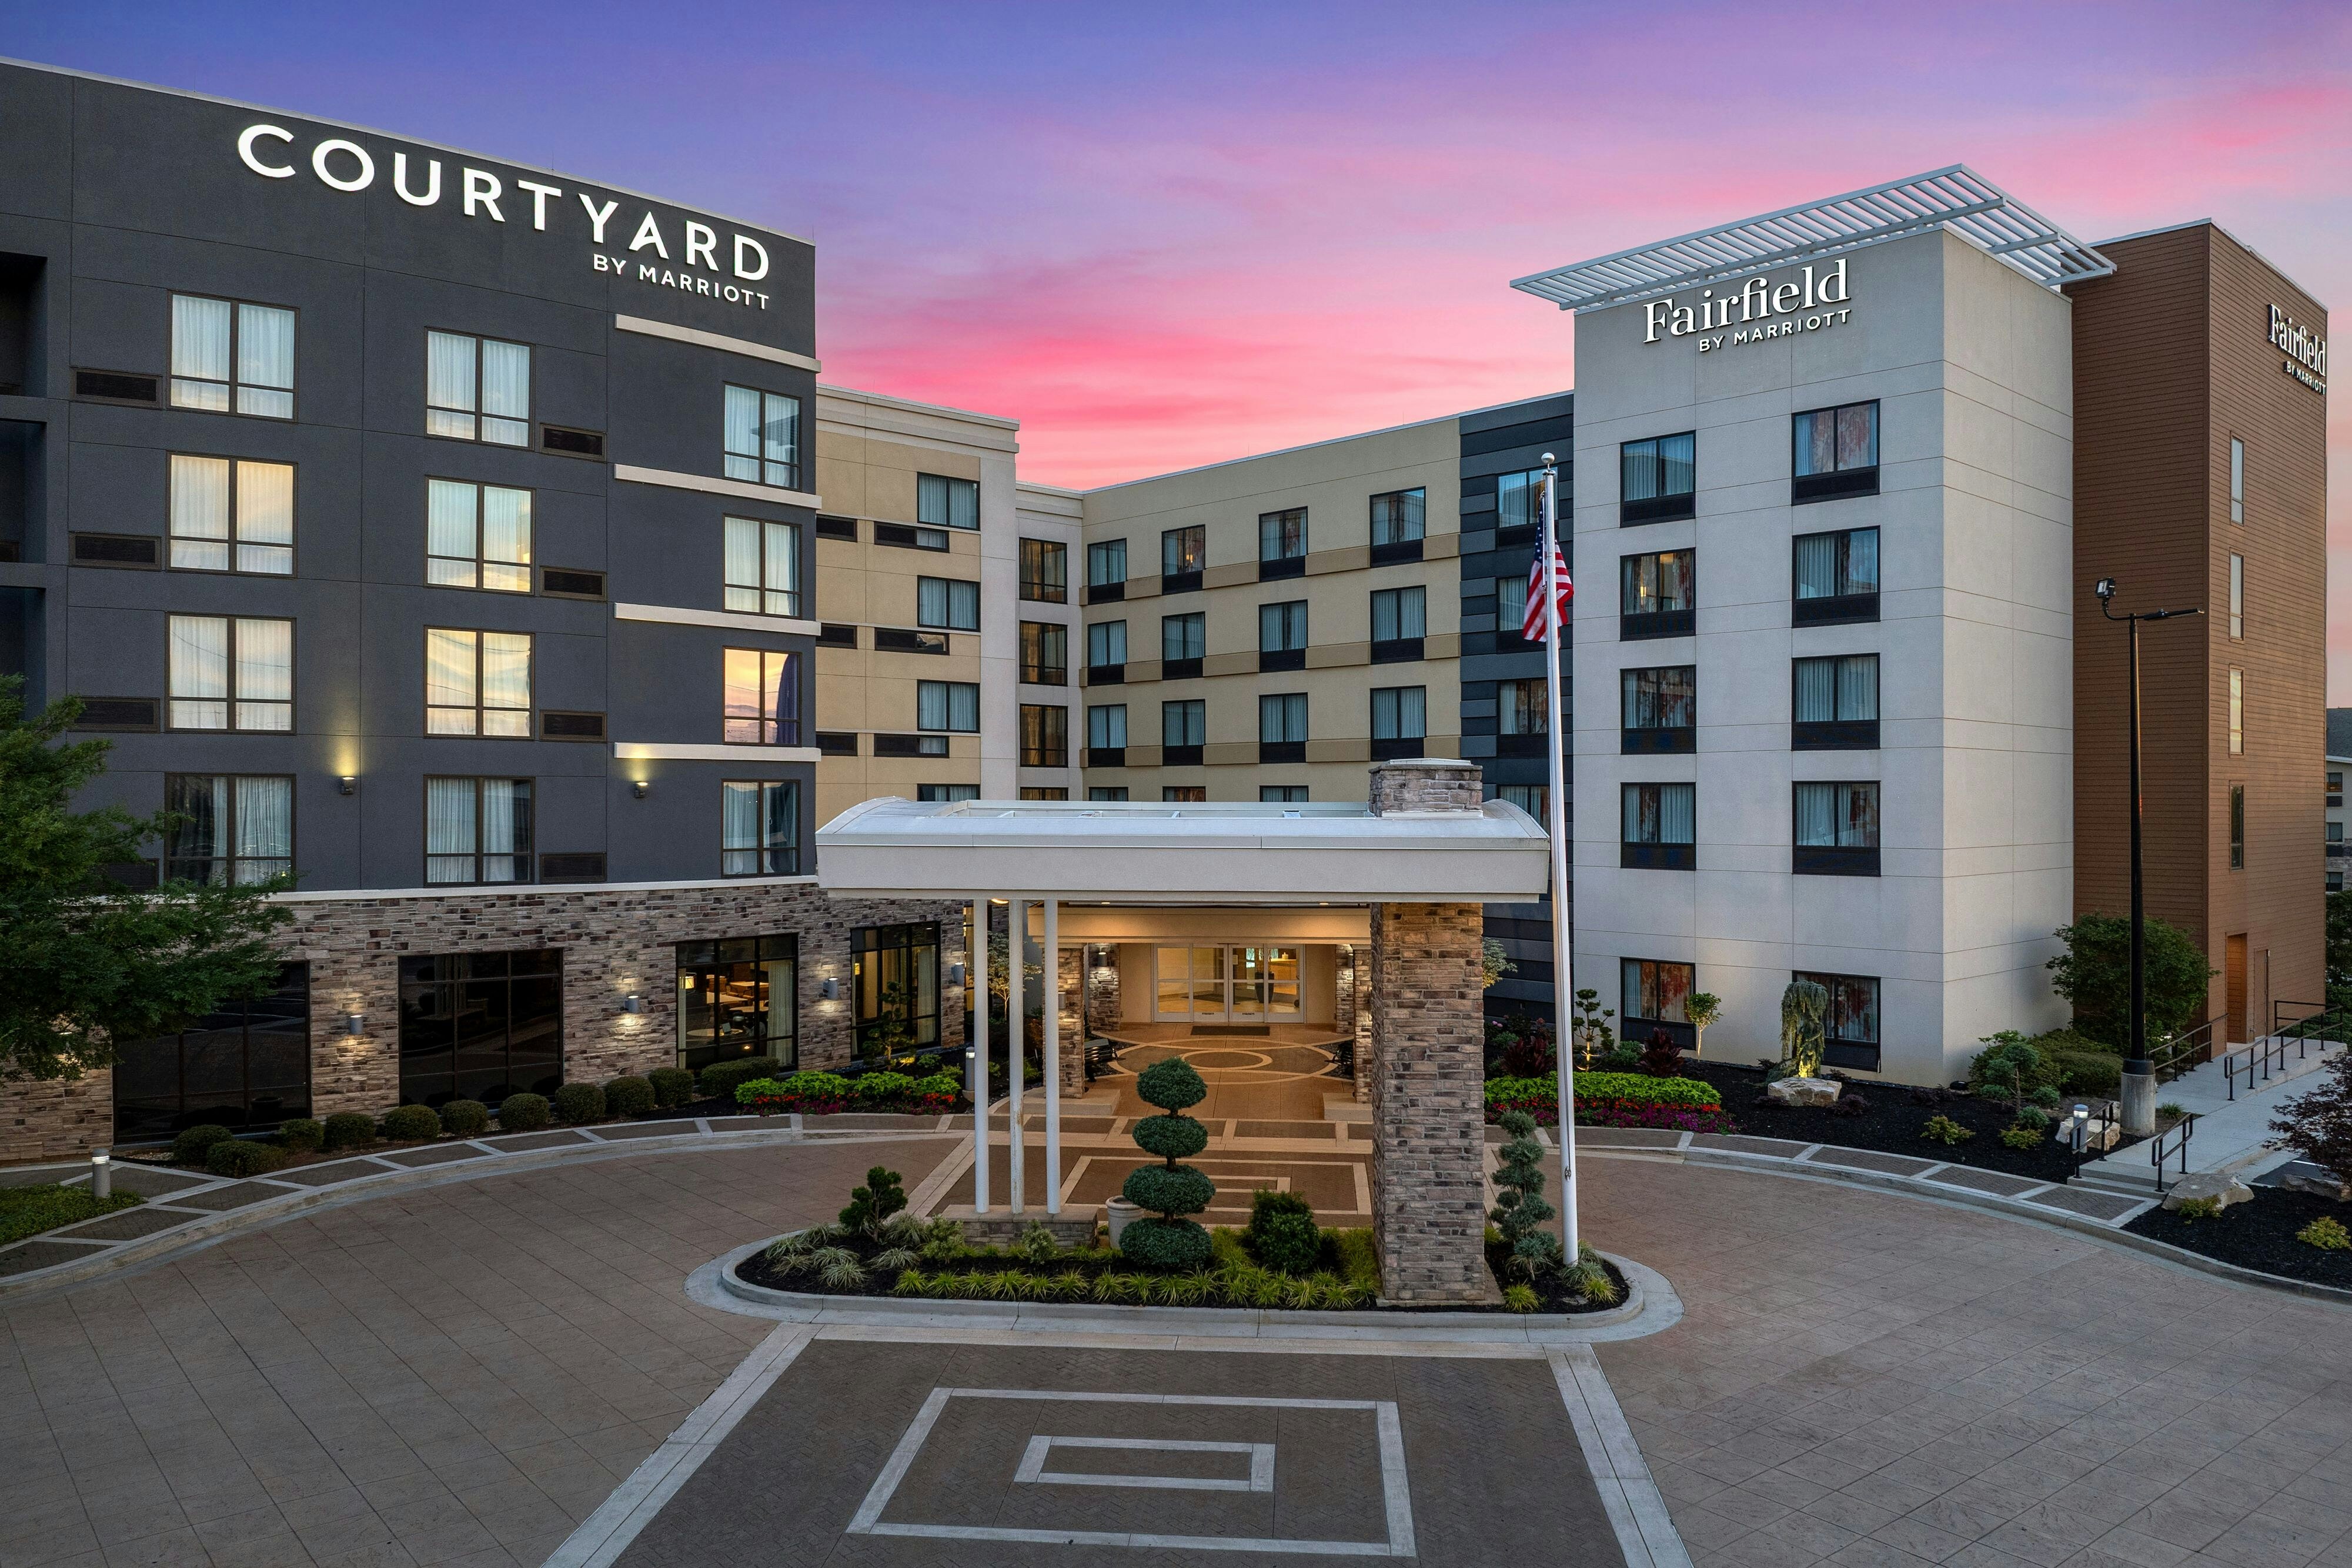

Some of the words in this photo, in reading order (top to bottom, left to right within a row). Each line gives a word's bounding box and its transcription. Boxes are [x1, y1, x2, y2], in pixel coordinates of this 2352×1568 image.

[238, 124, 769, 280] COURTYARD
[593, 253, 627, 275] BY
[639, 264, 769, 310] MARRIOTT
[1643, 258, 1850, 343] Fairfield
[1699, 335, 1724, 352] BY
[1734, 309, 1850, 345] MARRIOTT
[2270, 303, 2326, 377] Fairfield
[2286, 360, 2295, 375] BY
[2296, 367, 2326, 396] MARRIOTT
